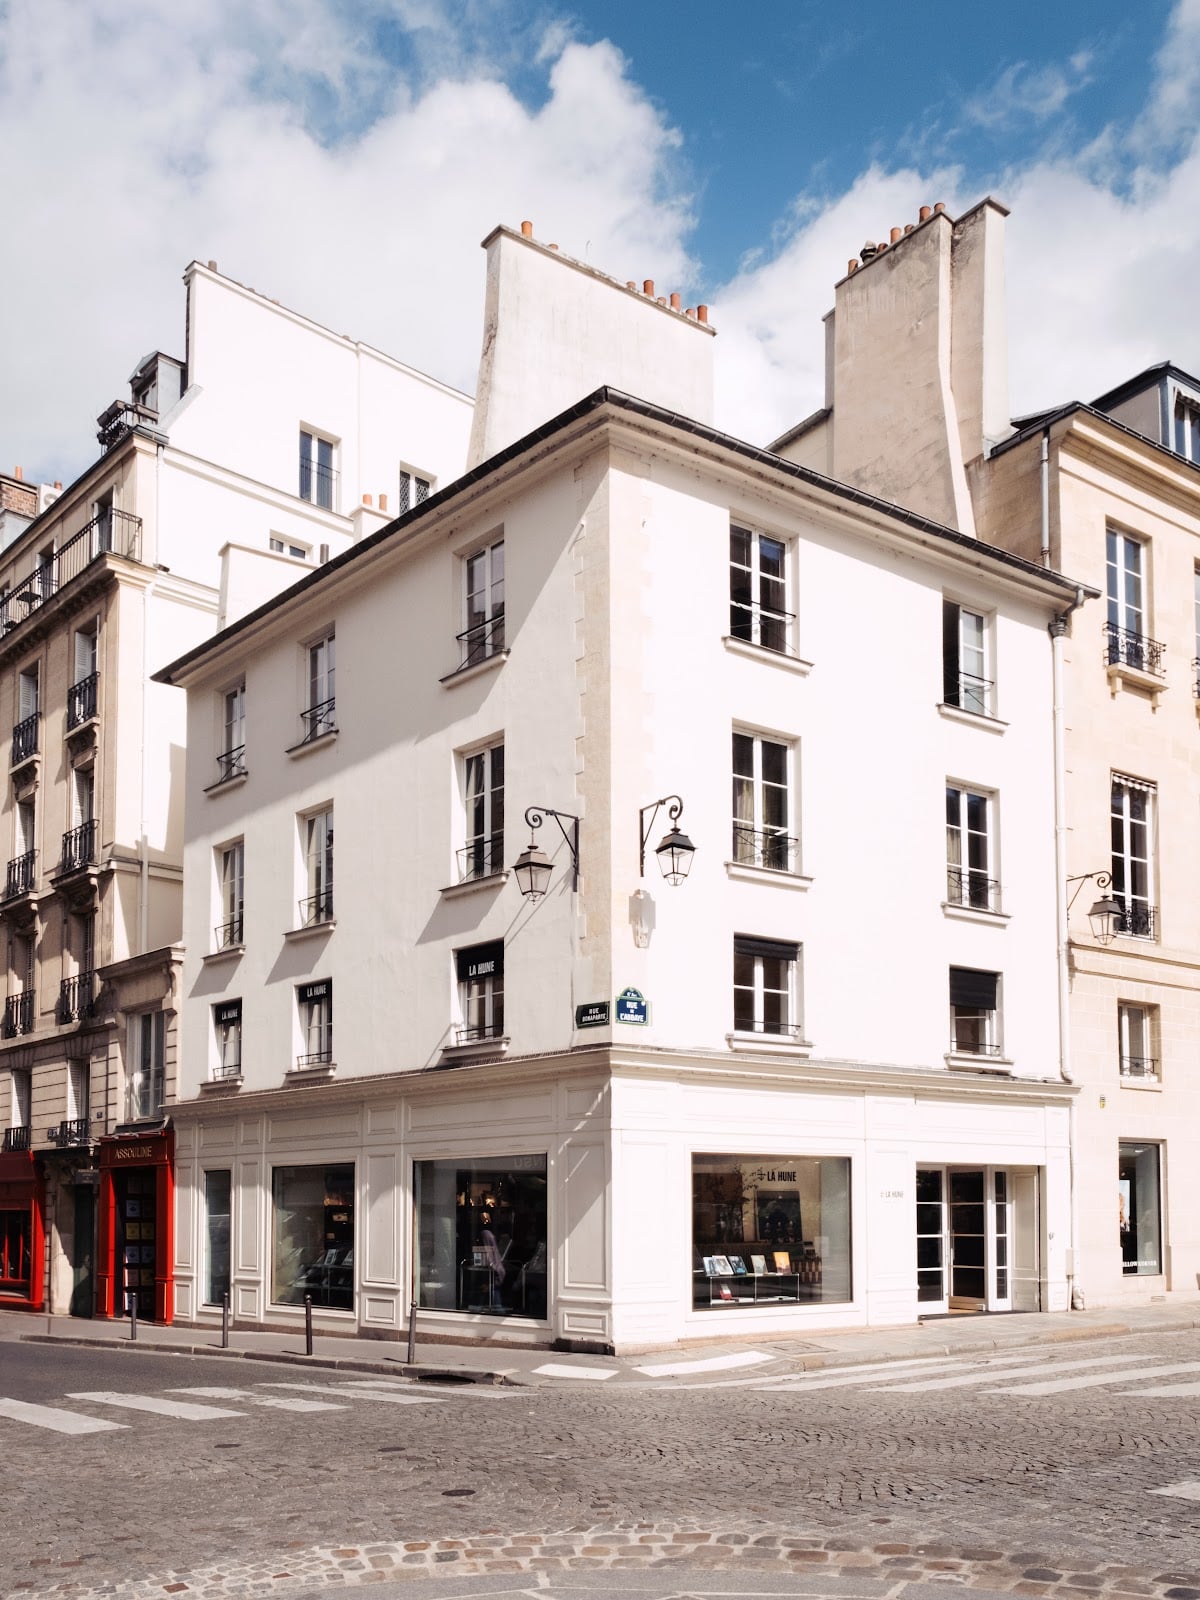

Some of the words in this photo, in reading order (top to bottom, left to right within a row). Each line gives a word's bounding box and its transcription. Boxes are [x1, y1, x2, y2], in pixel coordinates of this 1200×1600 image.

[469, 965, 476, 976] LA
[478, 961, 494, 974] HUNE
[307, 987, 313, 997] LA
[314, 985, 326, 996] HUNE
[627, 1001, 638, 1009] RUE
[582, 1013, 606, 1022] BONAPARTE
[115, 1146, 152, 1159] ASSOULINE
[767, 1171, 775, 1181] LA
[778, 1171, 796, 1181] HUNE
